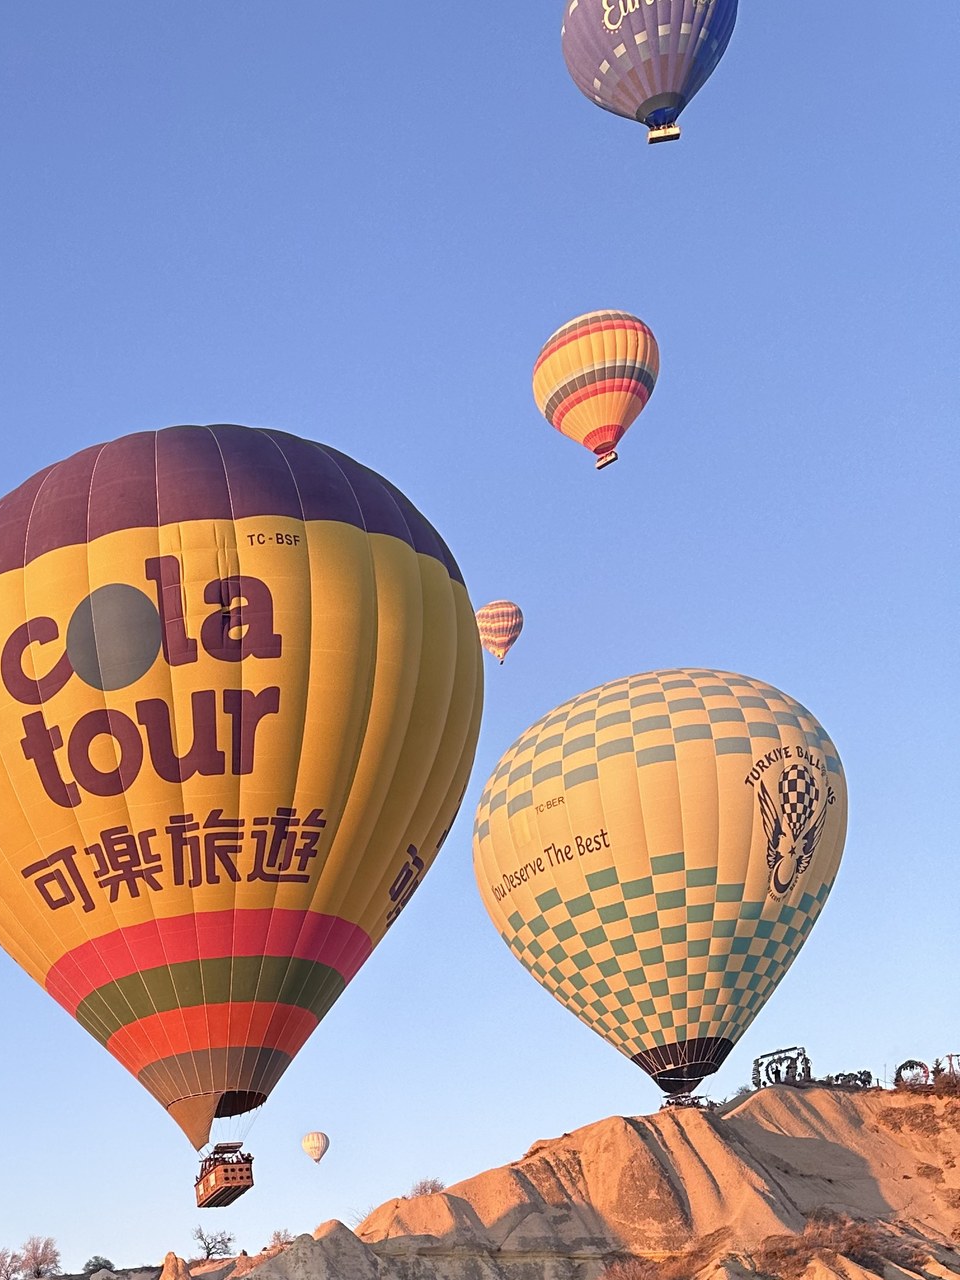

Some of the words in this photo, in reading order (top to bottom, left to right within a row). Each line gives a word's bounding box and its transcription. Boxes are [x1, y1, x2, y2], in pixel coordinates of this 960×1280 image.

[246, 533, 300, 546] TC-BSF
[0, 554, 282, 705] cola
[20, 686, 281, 808] tour
[20, 807, 327, 913] 可樂旅遊
[502, 857, 545, 893] Deserve
[543, 843, 574, 867] The
[574, 828, 610, 857] Best
